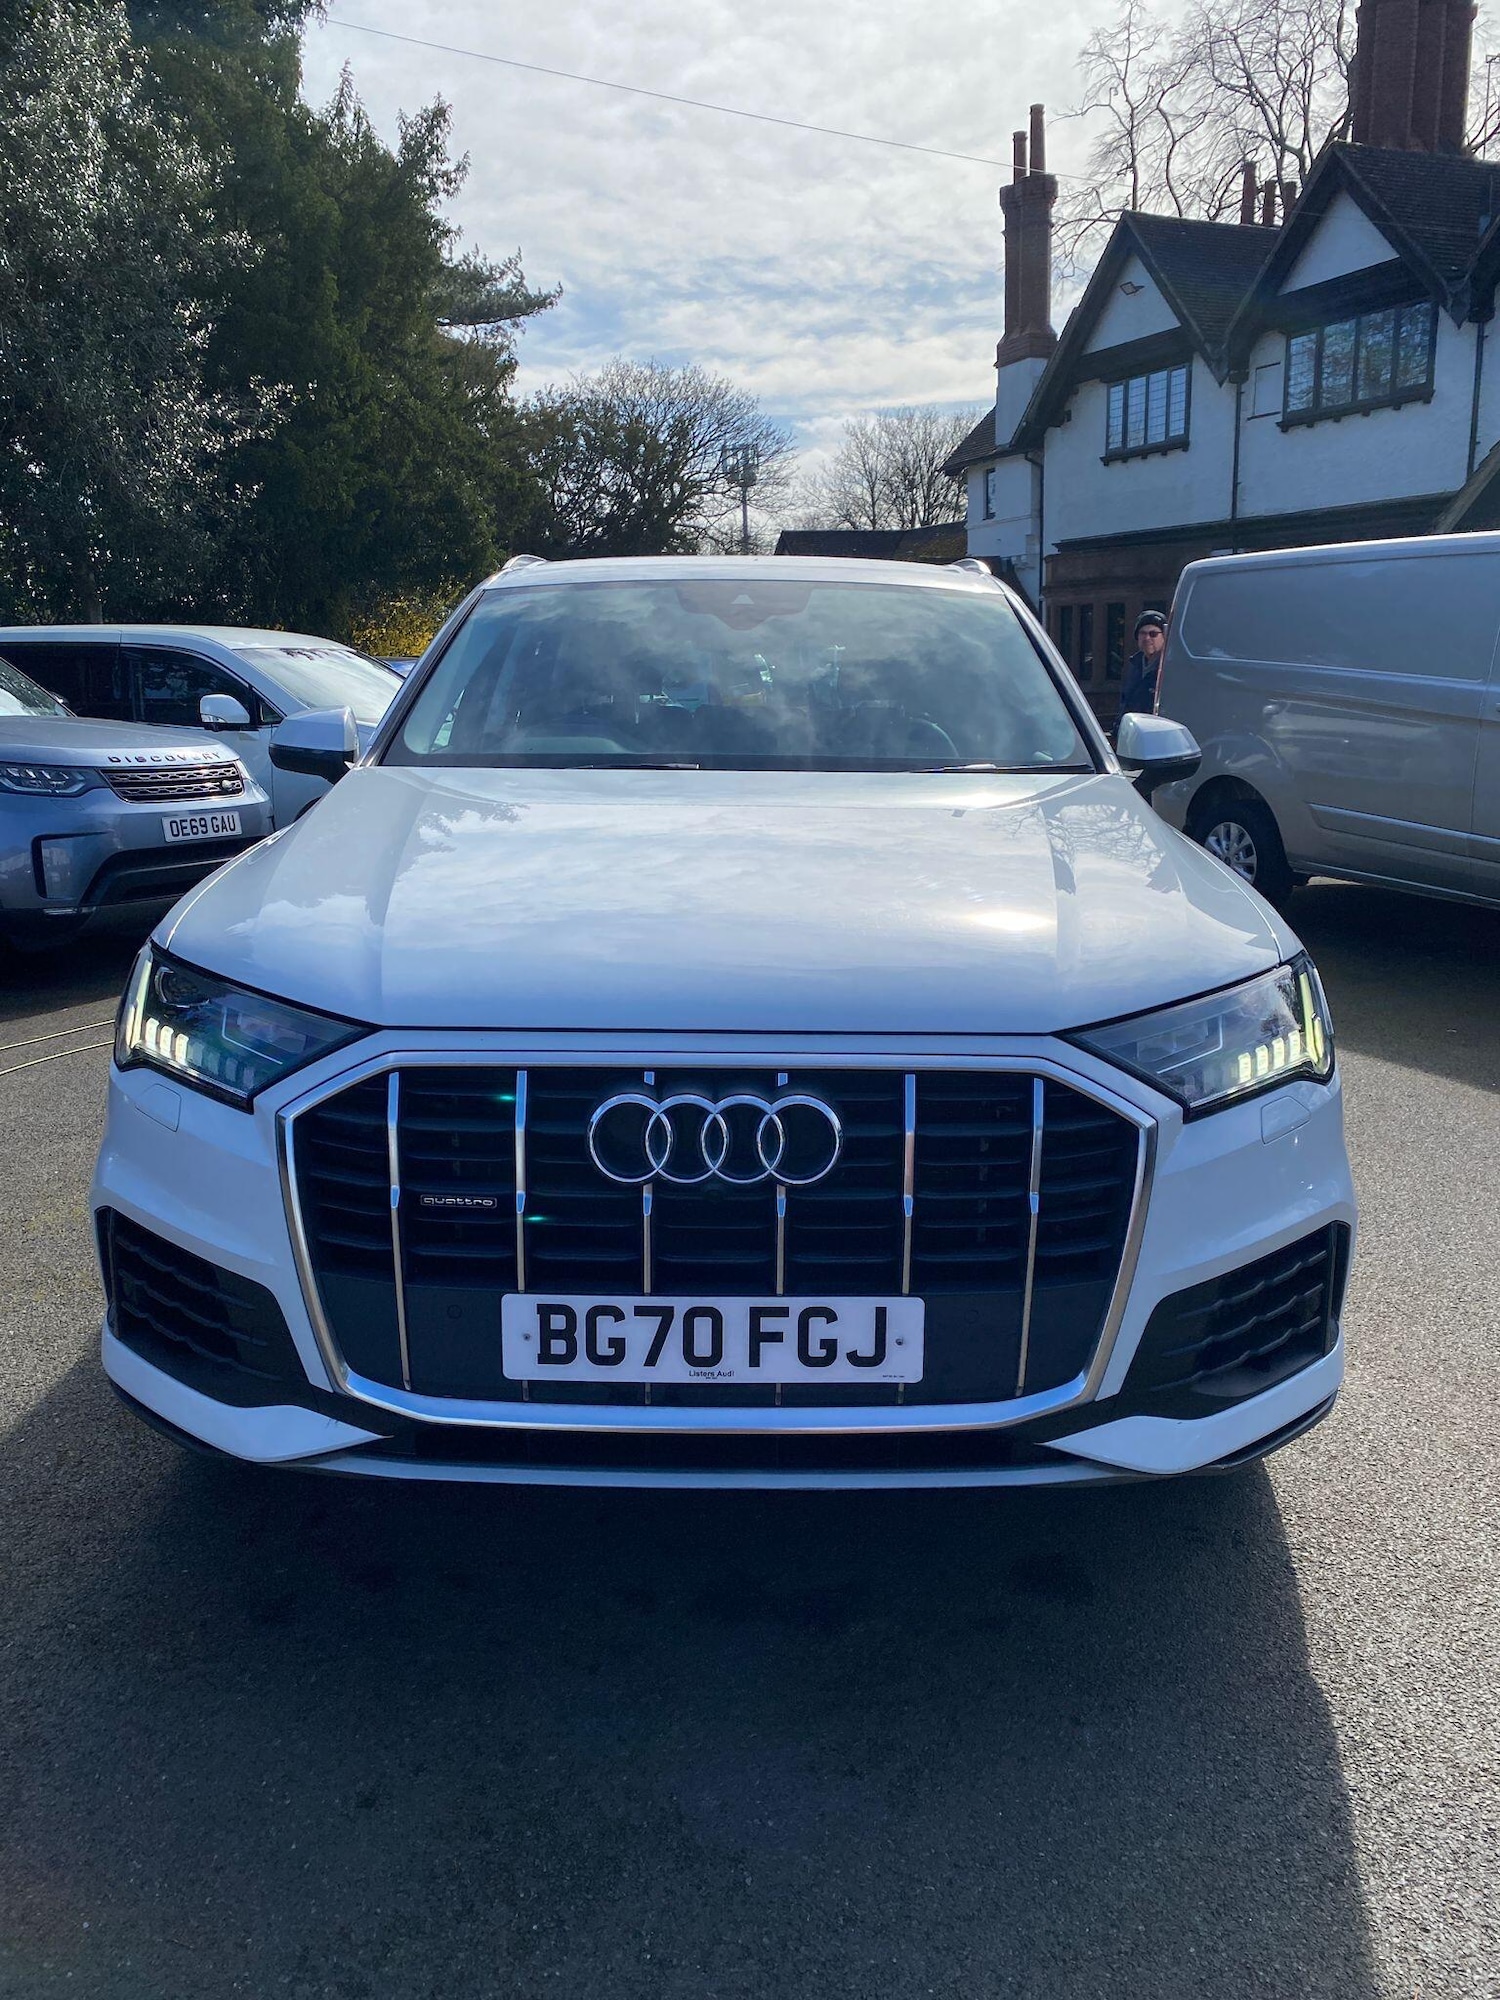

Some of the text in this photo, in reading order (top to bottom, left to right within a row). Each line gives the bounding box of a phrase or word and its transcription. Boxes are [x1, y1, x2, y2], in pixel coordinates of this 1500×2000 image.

[107, 751, 221, 763] DISCOVERY
[169, 814, 236, 838] OE69 GAU
[423, 1197, 494, 1206] quattro
[536, 1303, 888, 1368] BG70 FGJ
